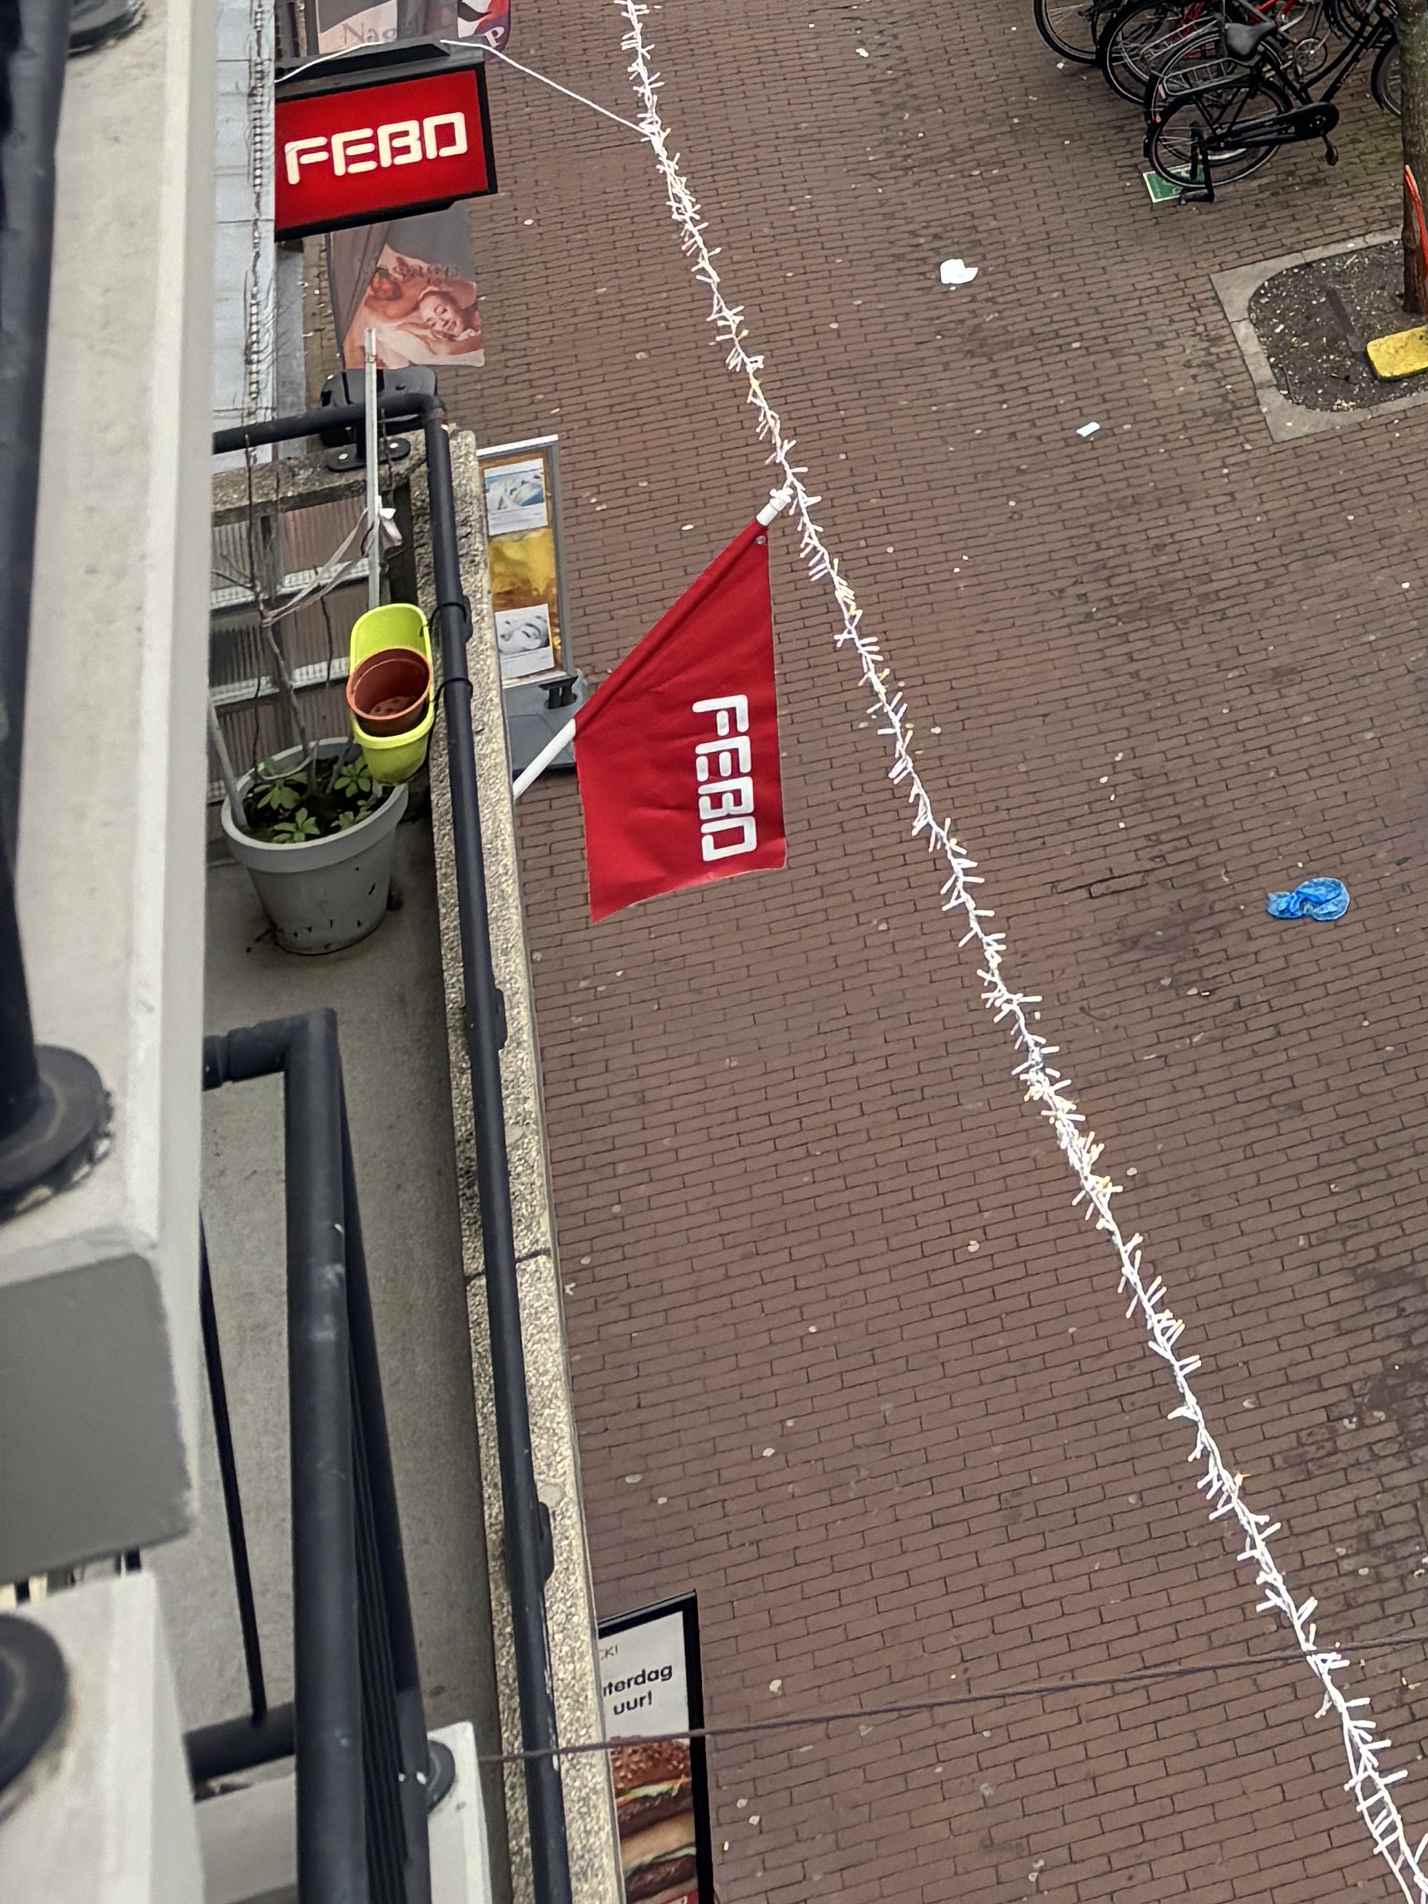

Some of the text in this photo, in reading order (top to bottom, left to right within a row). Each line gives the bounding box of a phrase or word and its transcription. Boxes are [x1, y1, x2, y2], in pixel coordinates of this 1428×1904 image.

[284, 111, 468, 185] FEBO
[692, 694, 757, 862] FEBO
[613, 1690, 653, 1715] uur!
